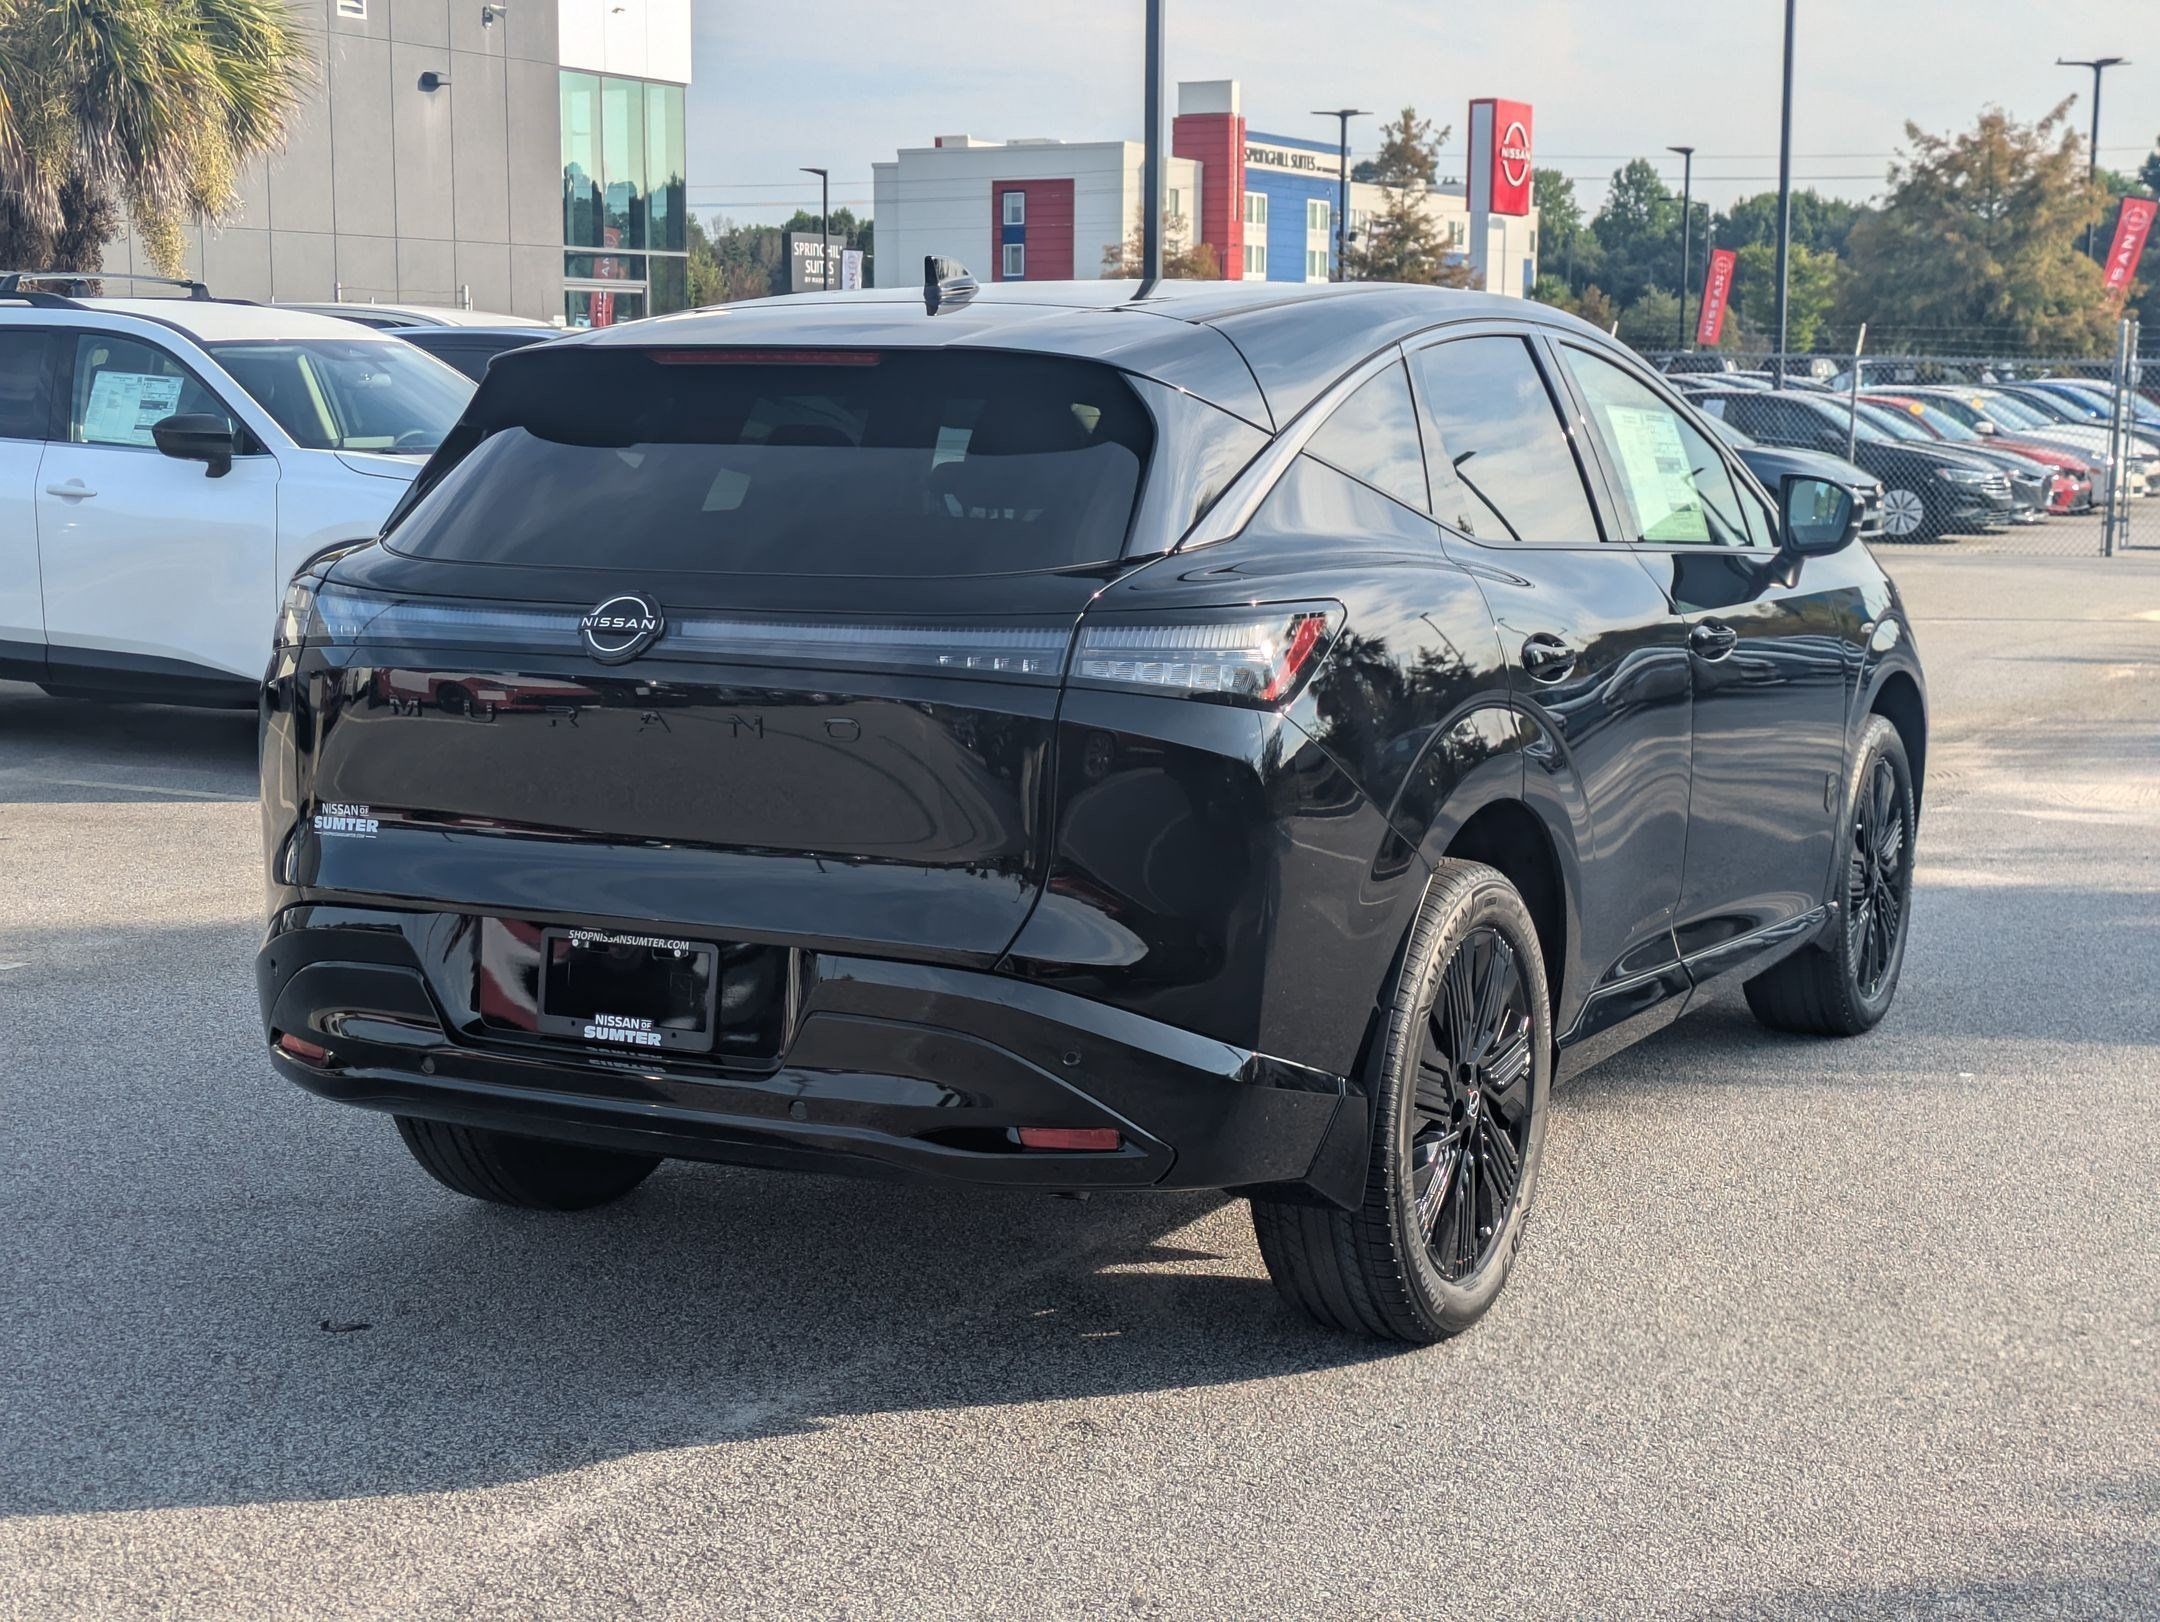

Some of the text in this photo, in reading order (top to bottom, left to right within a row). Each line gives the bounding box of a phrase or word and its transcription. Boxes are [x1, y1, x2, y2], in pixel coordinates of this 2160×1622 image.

[1243, 147, 1289, 168] SPRINGHILL
[1291, 153, 1316, 171] SUITES
[1501, 146, 1531, 161] NISSAN
[805, 260, 834, 275] SUITS
[1704, 274, 1725, 337] NISSAN
[581, 617, 656, 630] NISSAN
[389, 694, 862, 743] MURANO
[322, 803, 370, 816] NISSAN OF
[314, 815, 379, 833] SUMTER
[595, 1014, 653, 1031] NISSAN OF
[583, 1025, 662, 1047] SUMTER
